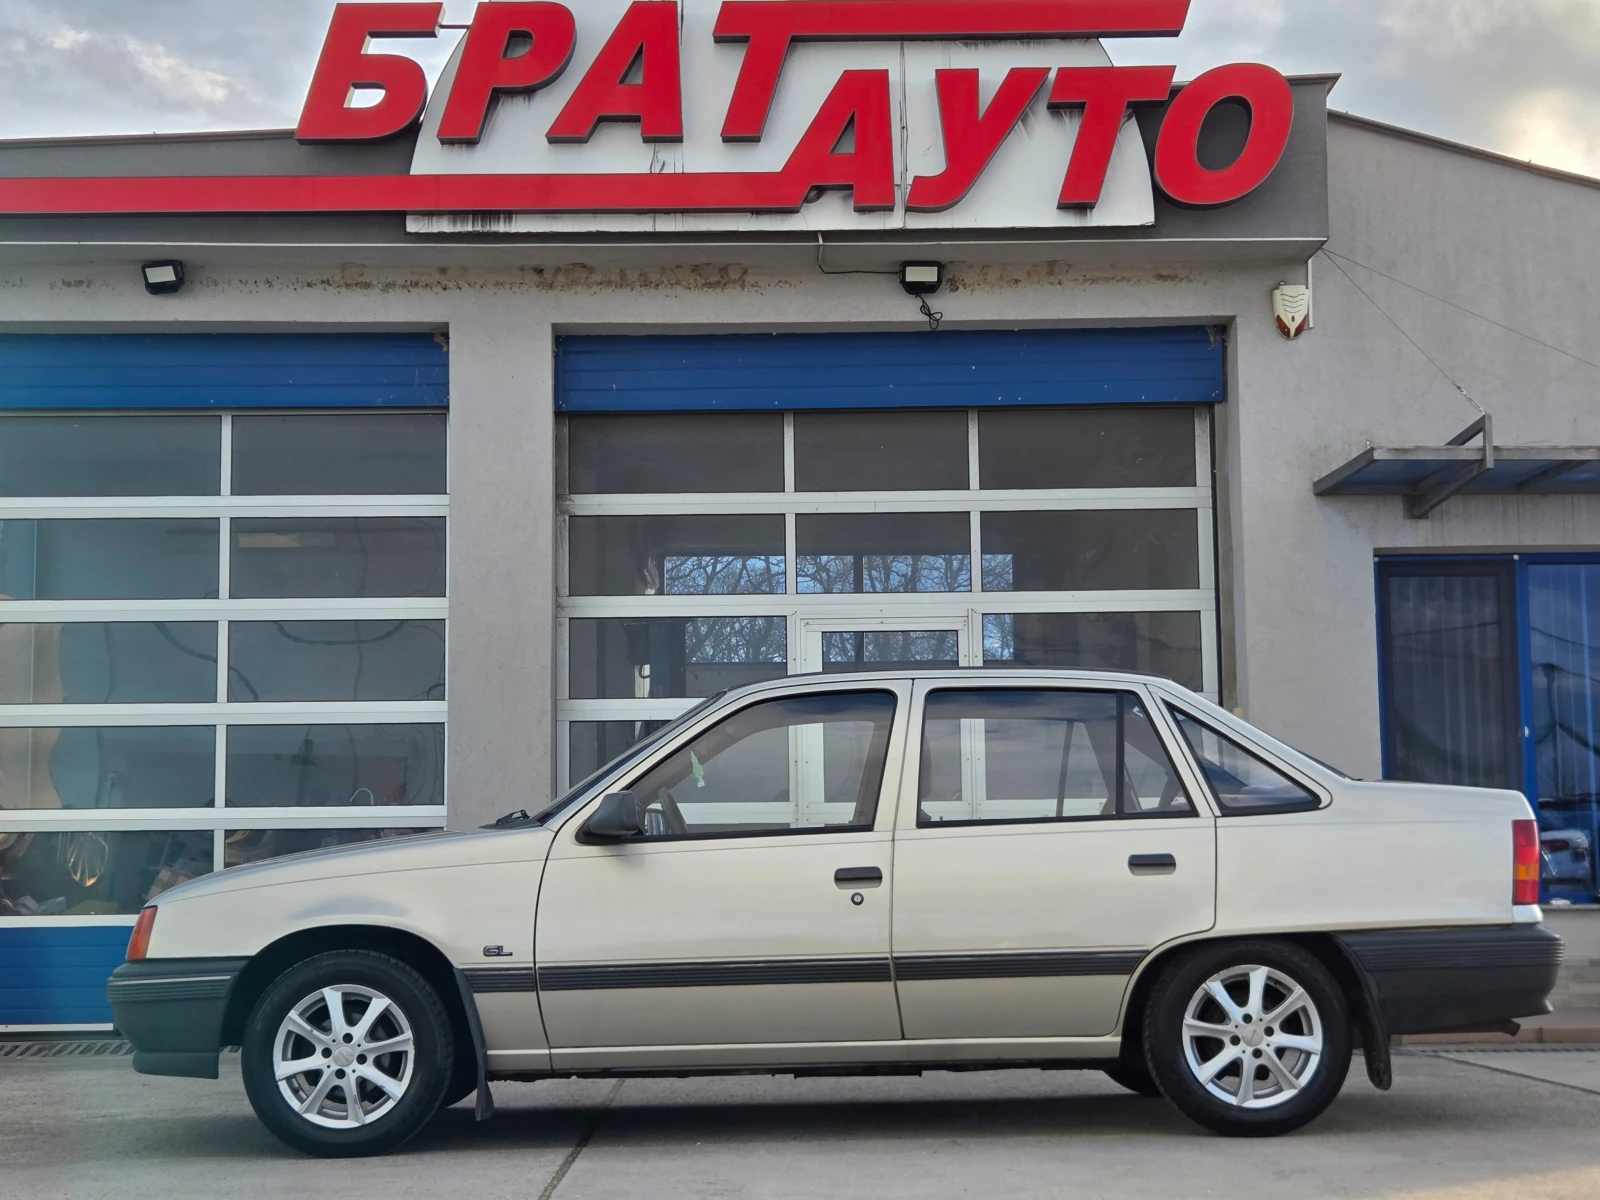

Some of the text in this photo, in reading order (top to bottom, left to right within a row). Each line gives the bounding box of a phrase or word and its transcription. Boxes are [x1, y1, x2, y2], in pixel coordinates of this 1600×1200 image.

[294, 0, 1190, 144] БРАТ
[780, 62, 1294, 212] АУТО
[483, 945, 513, 957] GL
